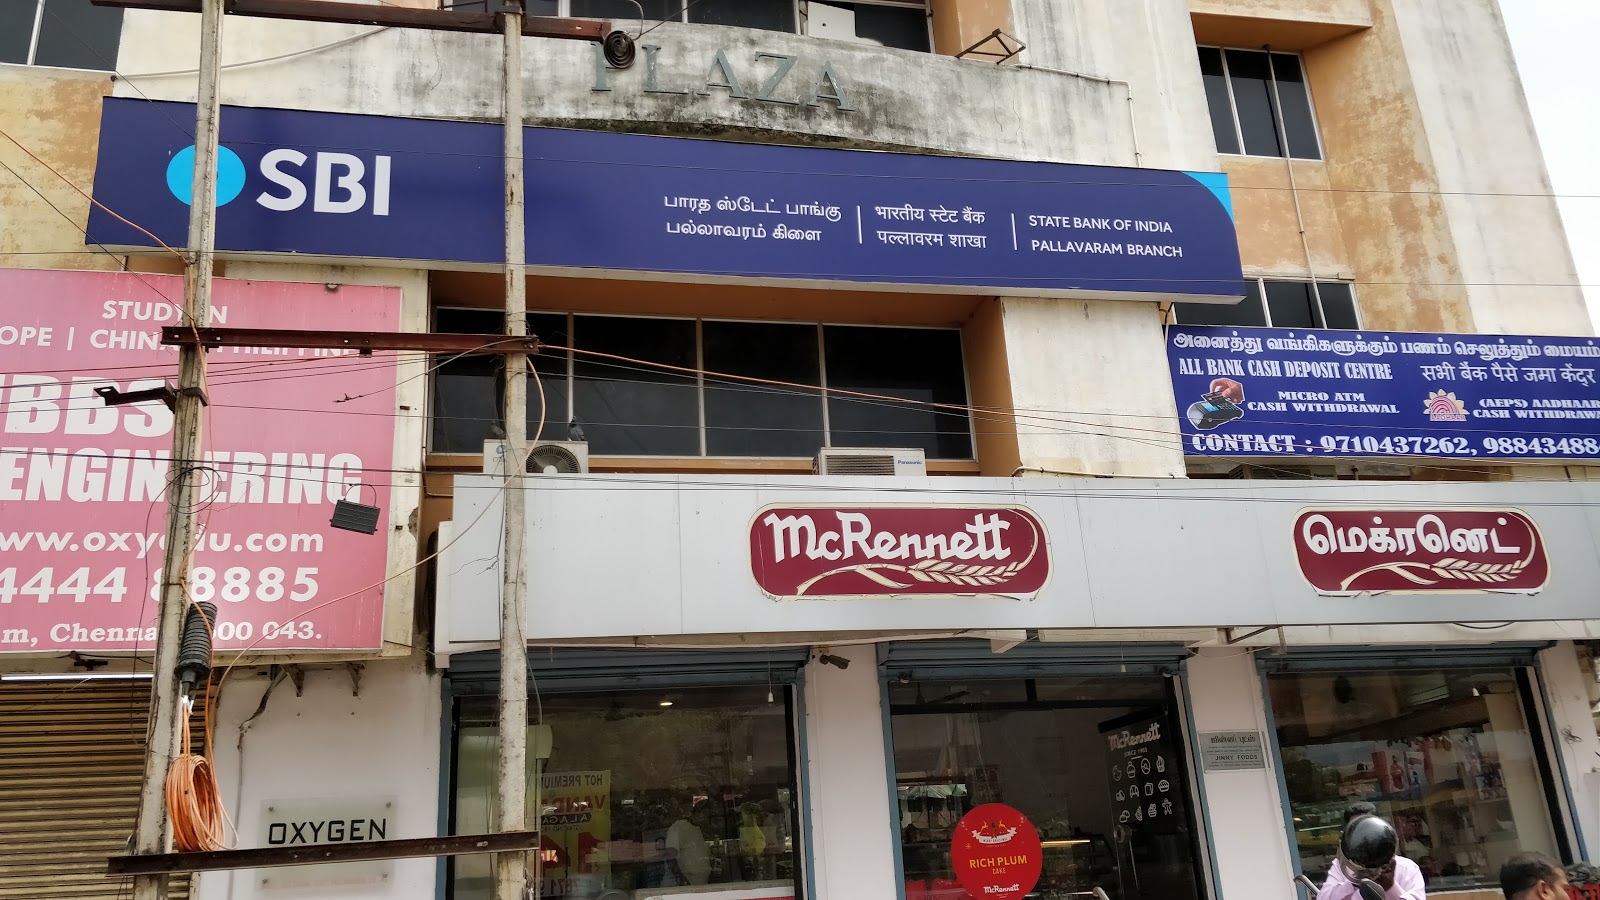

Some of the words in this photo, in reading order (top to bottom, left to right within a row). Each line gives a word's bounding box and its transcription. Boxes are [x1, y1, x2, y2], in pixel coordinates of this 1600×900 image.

[256, 149, 391, 216] SBI
[664, 196, 711, 214] பாரத
[717, 196, 781, 214] ஸ்டேட்
[786, 201, 842, 222] பாங்கு
[875, 204, 925, 222] भारतीय
[929, 205, 958, 223] स्टेट
[962, 205, 986, 225] बैंक
[667, 219, 766, 240] பல்லாவரம்
[772, 223, 822, 241] கிளை
[1029, 214, 1070, 228] STATE
[1074, 217, 1110, 230] BANK
[1113, 219, 1132, 231] OF
[1135, 220, 1173, 233] INDIA
[877, 230, 943, 247] पल्लावरम
[949, 233, 986, 249] शाखा
[1032, 240, 1123, 255] PALLAVARAM
[1127, 244, 1182, 258] BRANCH
[209, 305, 228, 324] N
[0, 326, 52, 346] OPE
[1174, 331, 1264, 355] அனைத்து
[1267, 332, 1398, 356] வங்கிகளுக்கும்
[1402, 336, 1451, 355] பணம்
[1454, 338, 1541, 361] செலுத்தும்
[1544, 340, 1600, 358] மையம்
[1179, 358, 1204, 375] ALL
[1206, 358, 1245, 376] BANK
[1248, 360, 1282, 377] CASH
[1284, 360, 1341, 379] DEPOSIT
[1344, 362, 1393, 380] CENTRE
[1420, 361, 1456, 381] सभी
[1459, 361, 1488, 382] बैंक
[1490, 362, 1519, 382] पैसे
[1521, 366, 1557, 383] जमा
[0, 374, 174, 437] BBS
[1278, 391, 1329, 401] MICRO
[1334, 392, 1366, 402] ATM
[1479, 398, 1529, 409] (AEPS)
[1247, 402, 1288, 412] CASH
[1292, 403, 1400, 414] WITHDRAWAL
[1472, 409, 1511, 419] CASH
[1192, 433, 1296, 453] CONTACT
[1320, 435, 1478, 456] 9710437262,
[1483, 436, 1600, 454] 98843488
[0, 447, 362, 504] ENGINERING
[0, 524, 324, 558] ww.oxydu.com
[763, 511, 1011, 563] McRennett
[50, 623, 157, 643] Chenna
[213, 621, 254, 642] 00
[263, 621, 322, 641] 043.
[1108, 722, 1160, 751] McRennett
[268, 818, 387, 845] OXYGEN
[969, 858, 995, 869] RICH
[998, 855, 1027, 866] PLUM
[992, 867, 1007, 875] CAKE
[984, 883, 1020, 894] McRennett
